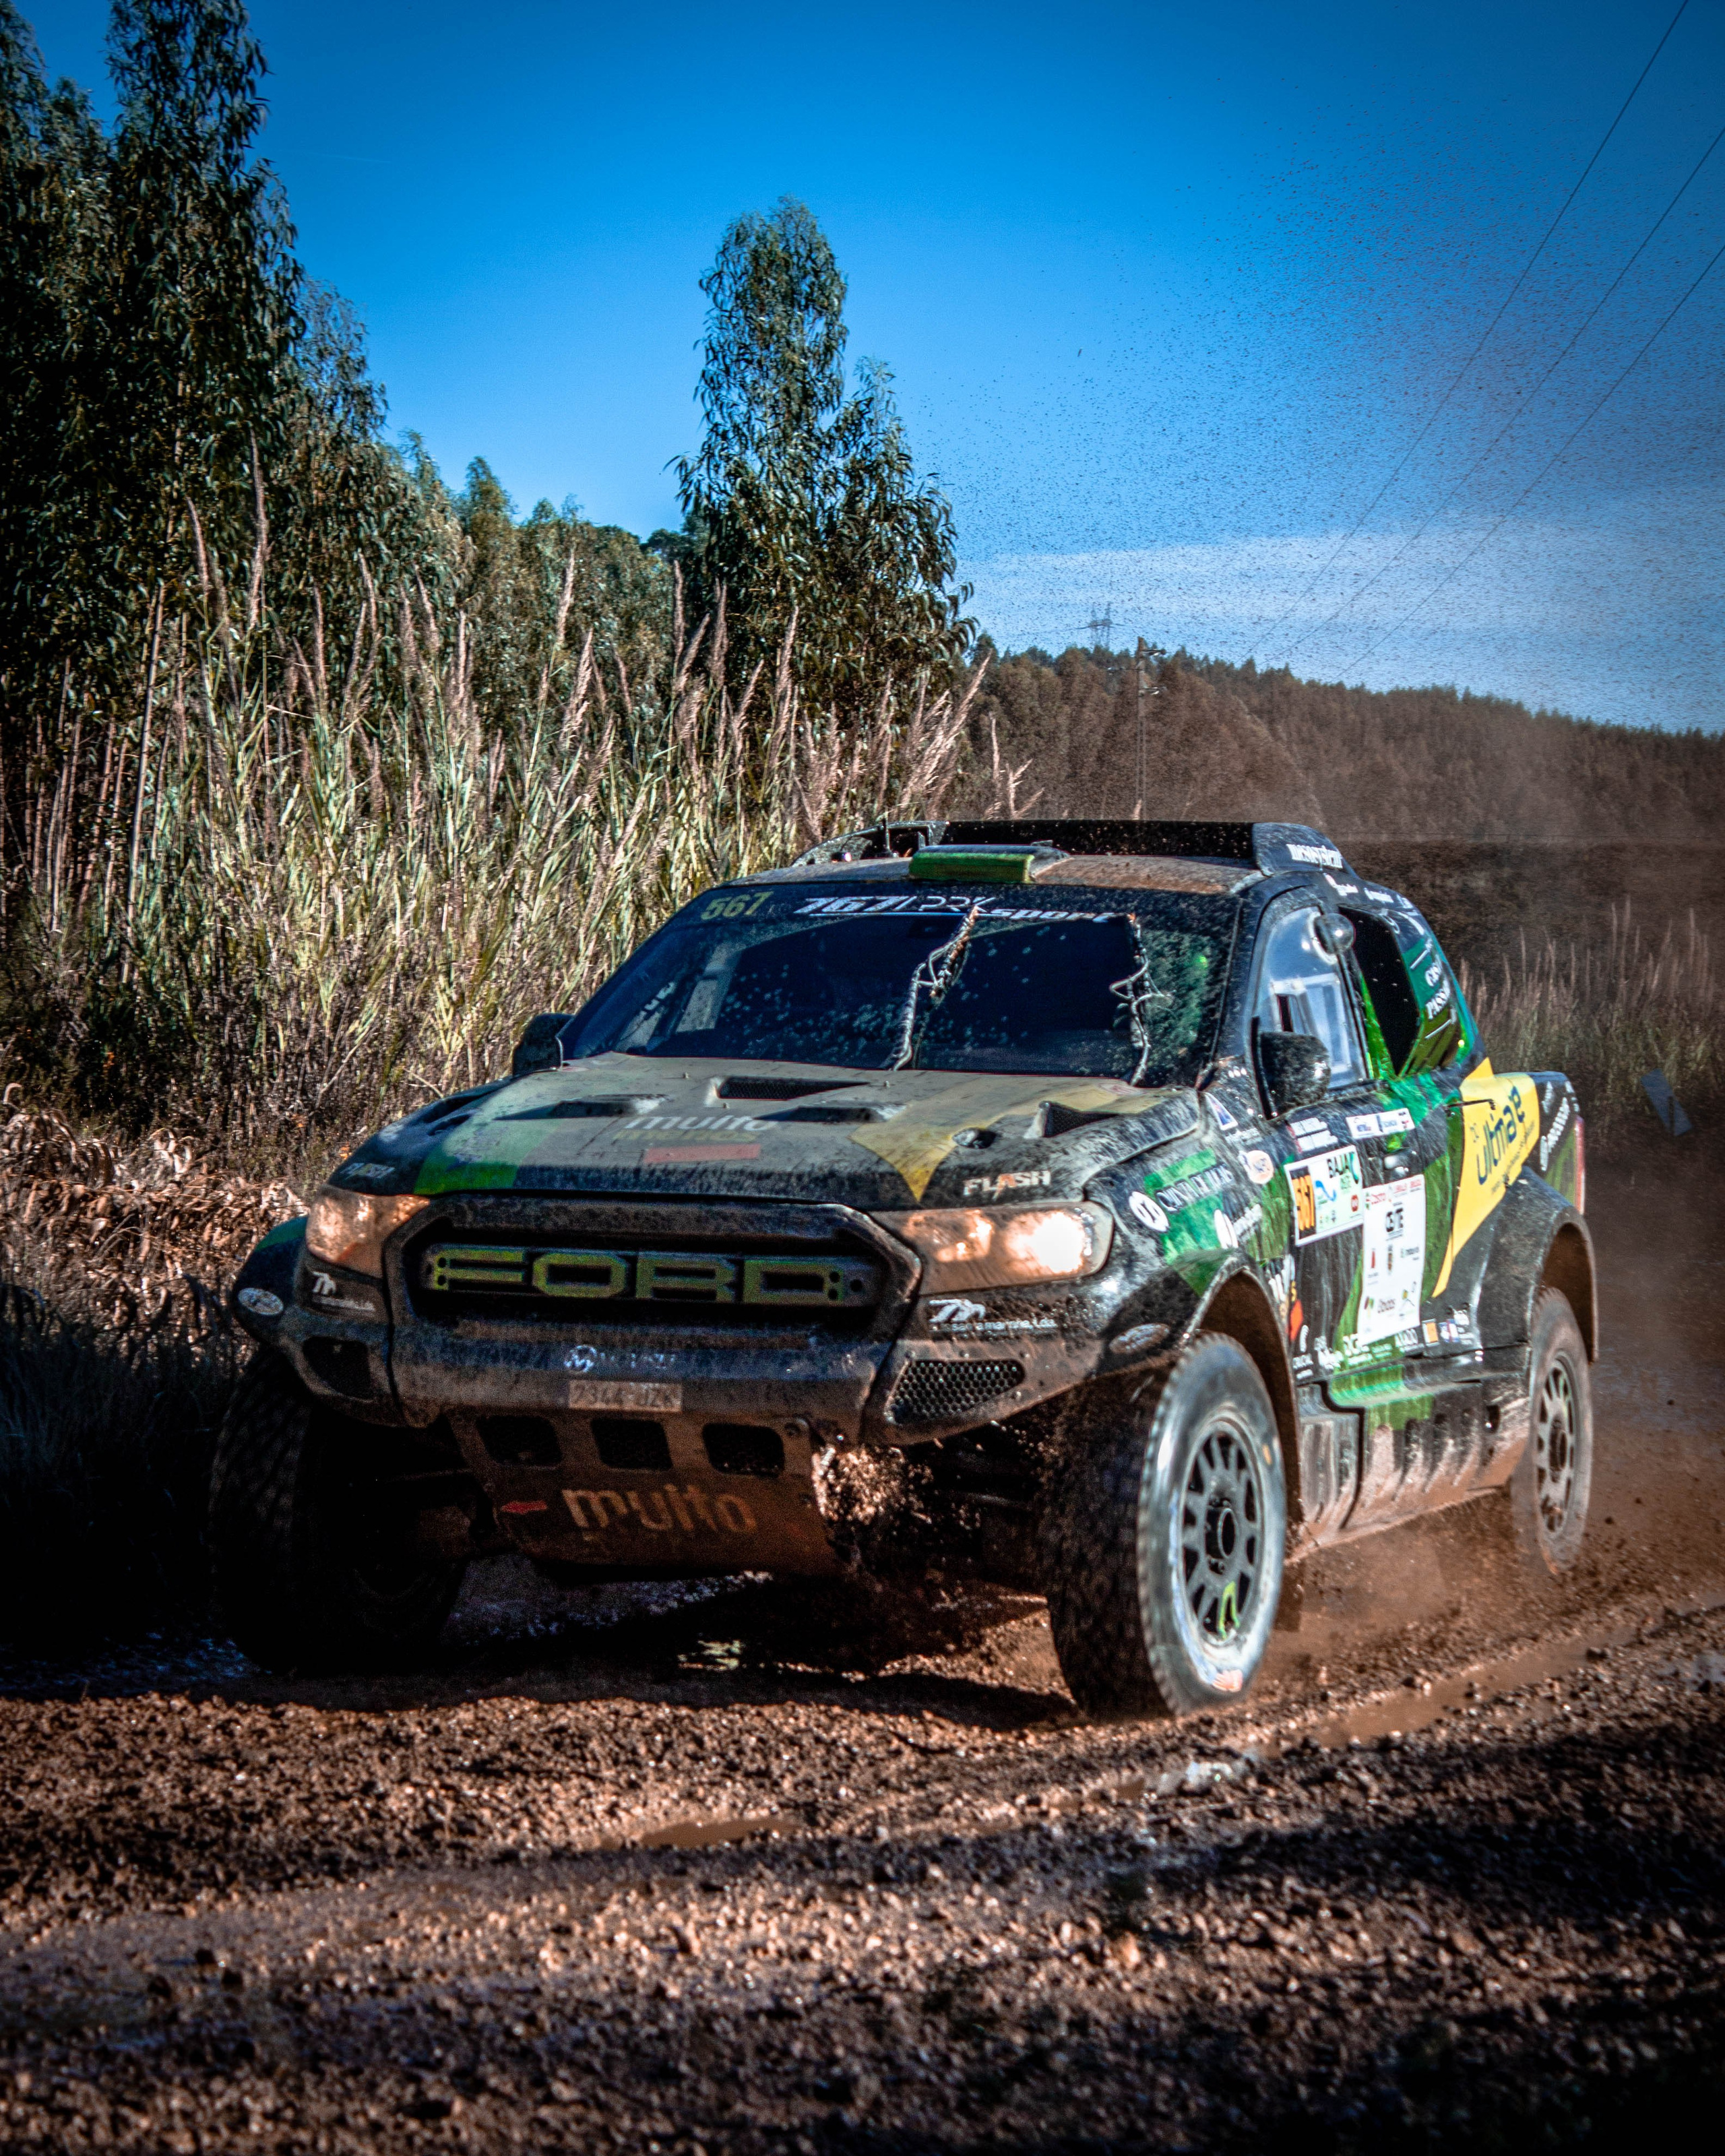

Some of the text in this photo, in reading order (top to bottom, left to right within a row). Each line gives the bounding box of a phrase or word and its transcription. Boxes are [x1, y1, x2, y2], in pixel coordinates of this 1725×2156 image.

[701, 891, 774, 920] 567
[990, 908, 1116, 923] sport
[963, 1170, 1051, 1199] FLASH
[431, 1245, 844, 1306] FORD
